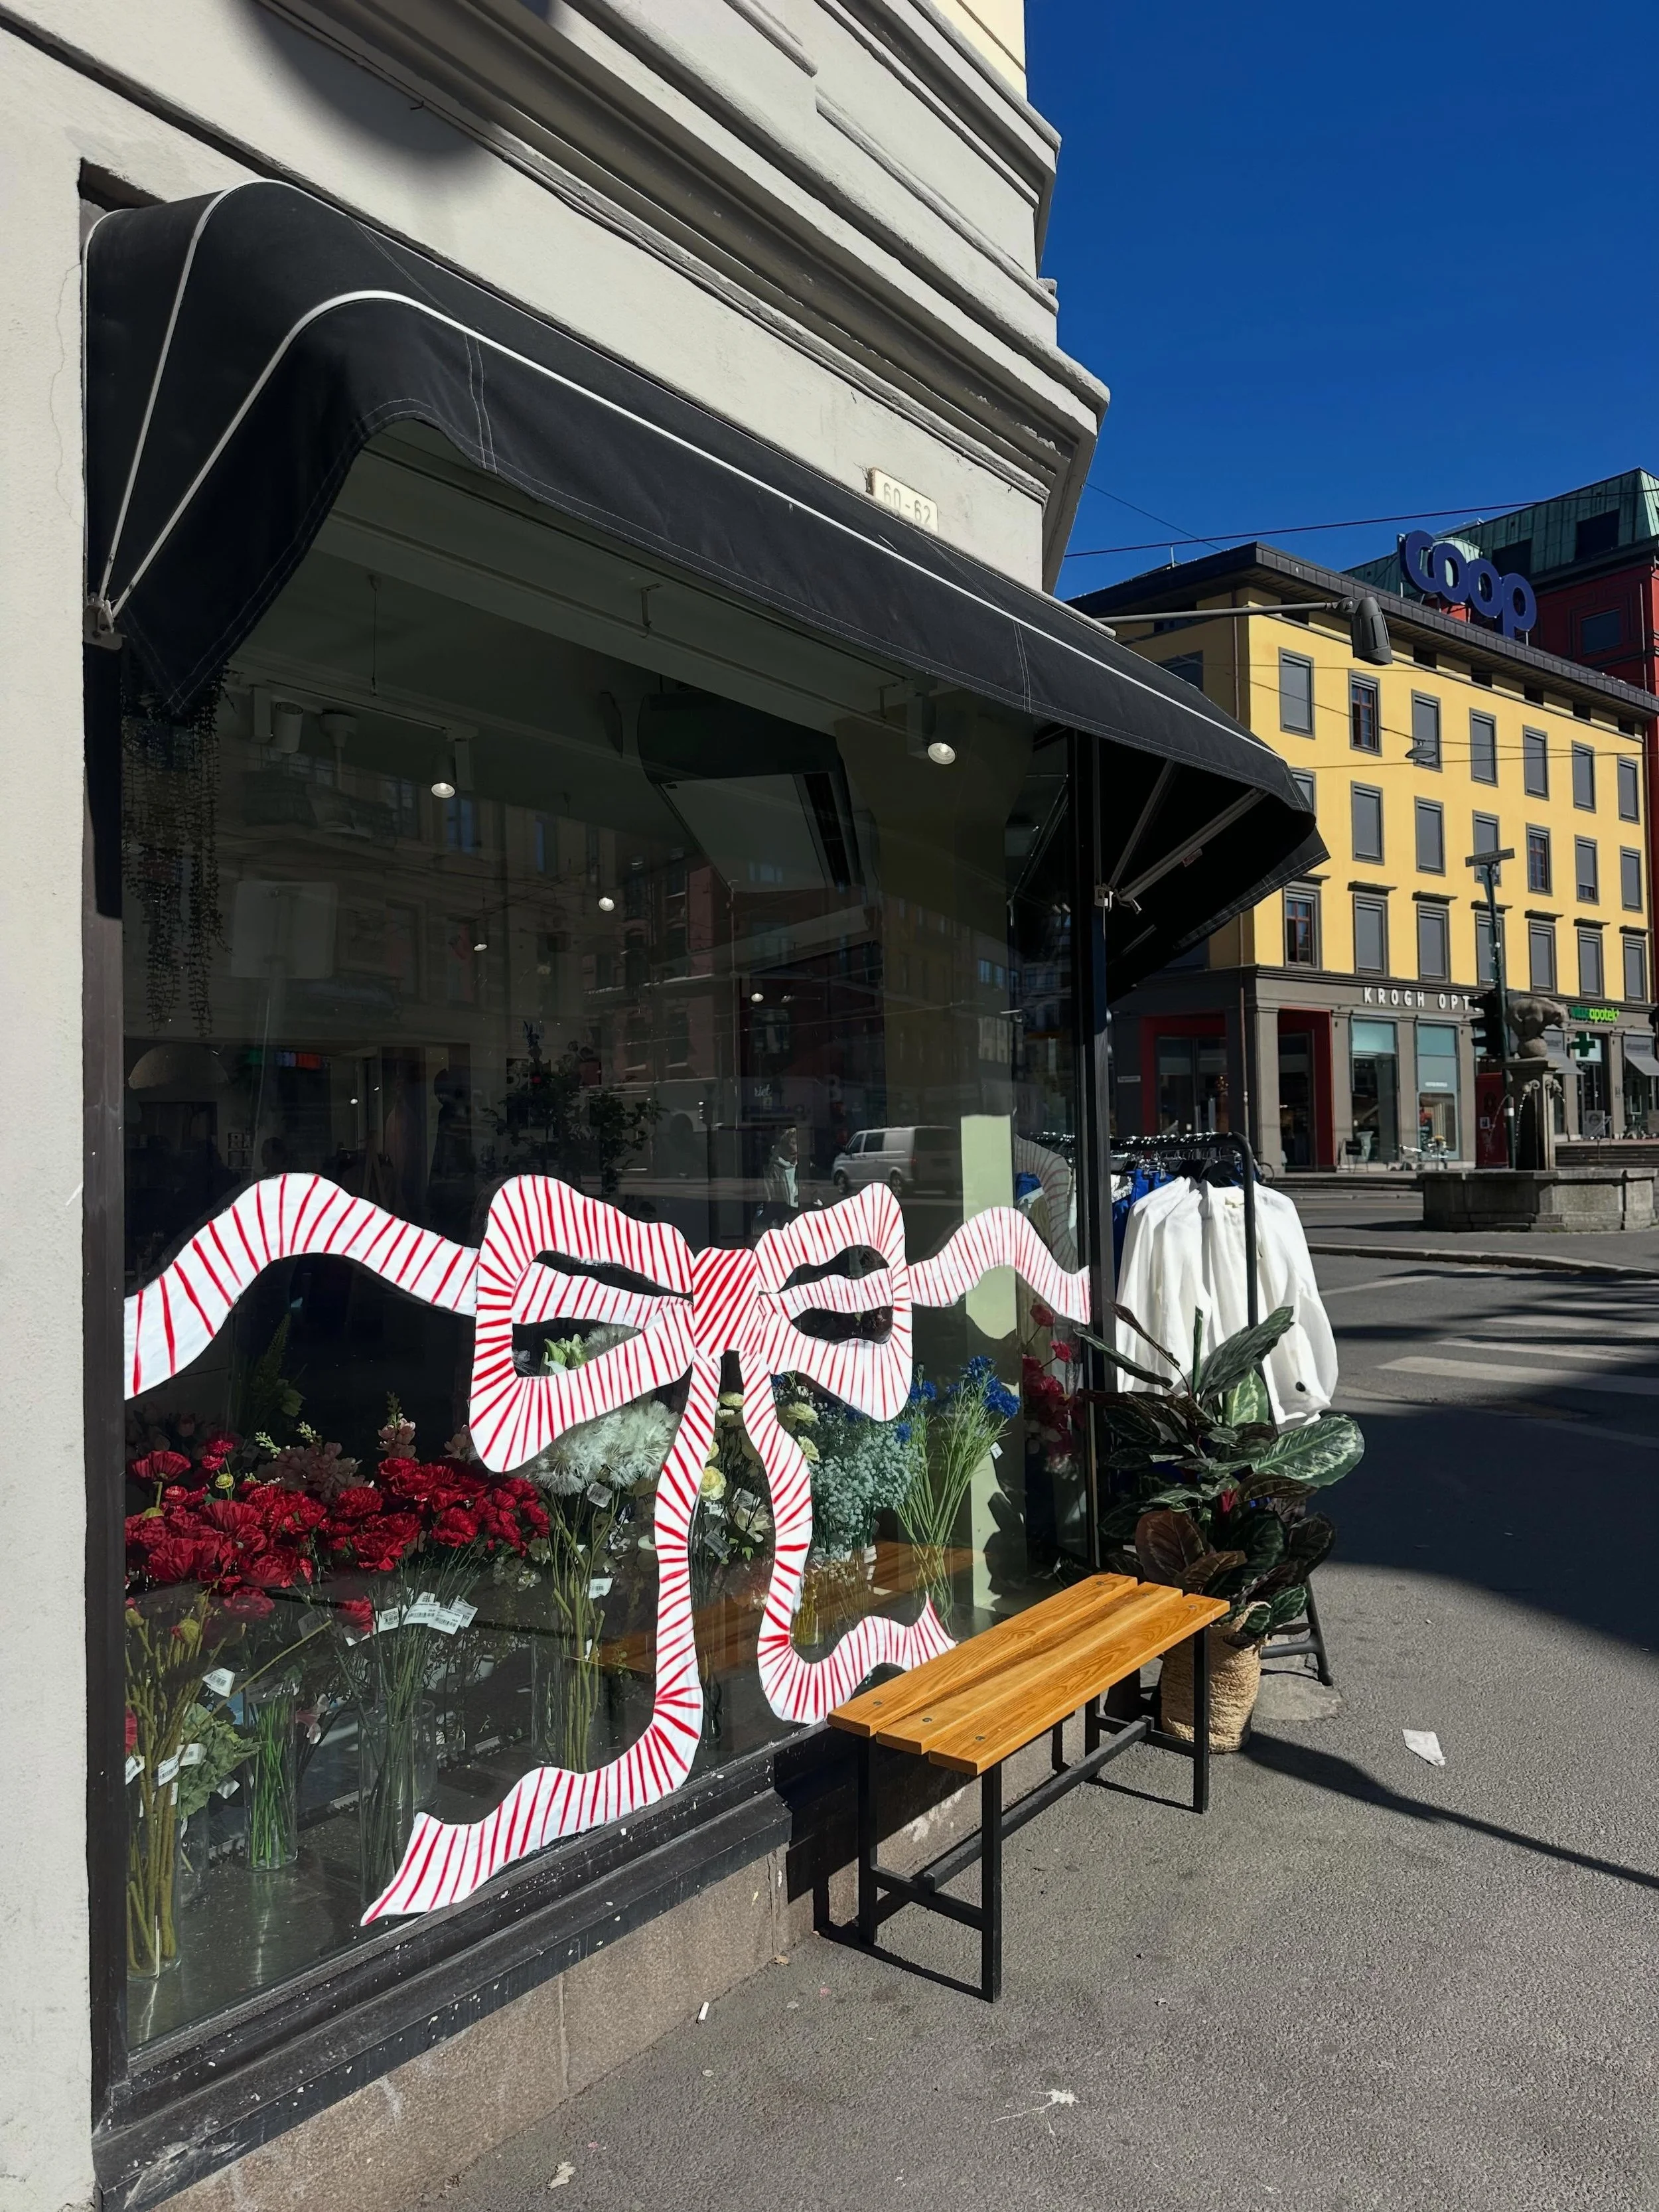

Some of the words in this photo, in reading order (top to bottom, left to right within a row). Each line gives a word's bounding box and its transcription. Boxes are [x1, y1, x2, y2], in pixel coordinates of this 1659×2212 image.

[883, 482, 931, 525] 60-62
[1399, 530, 1537, 639] coop
[1364, 987, 1425, 1007] KROGH
[1439, 994, 1480, 1011] OPT
